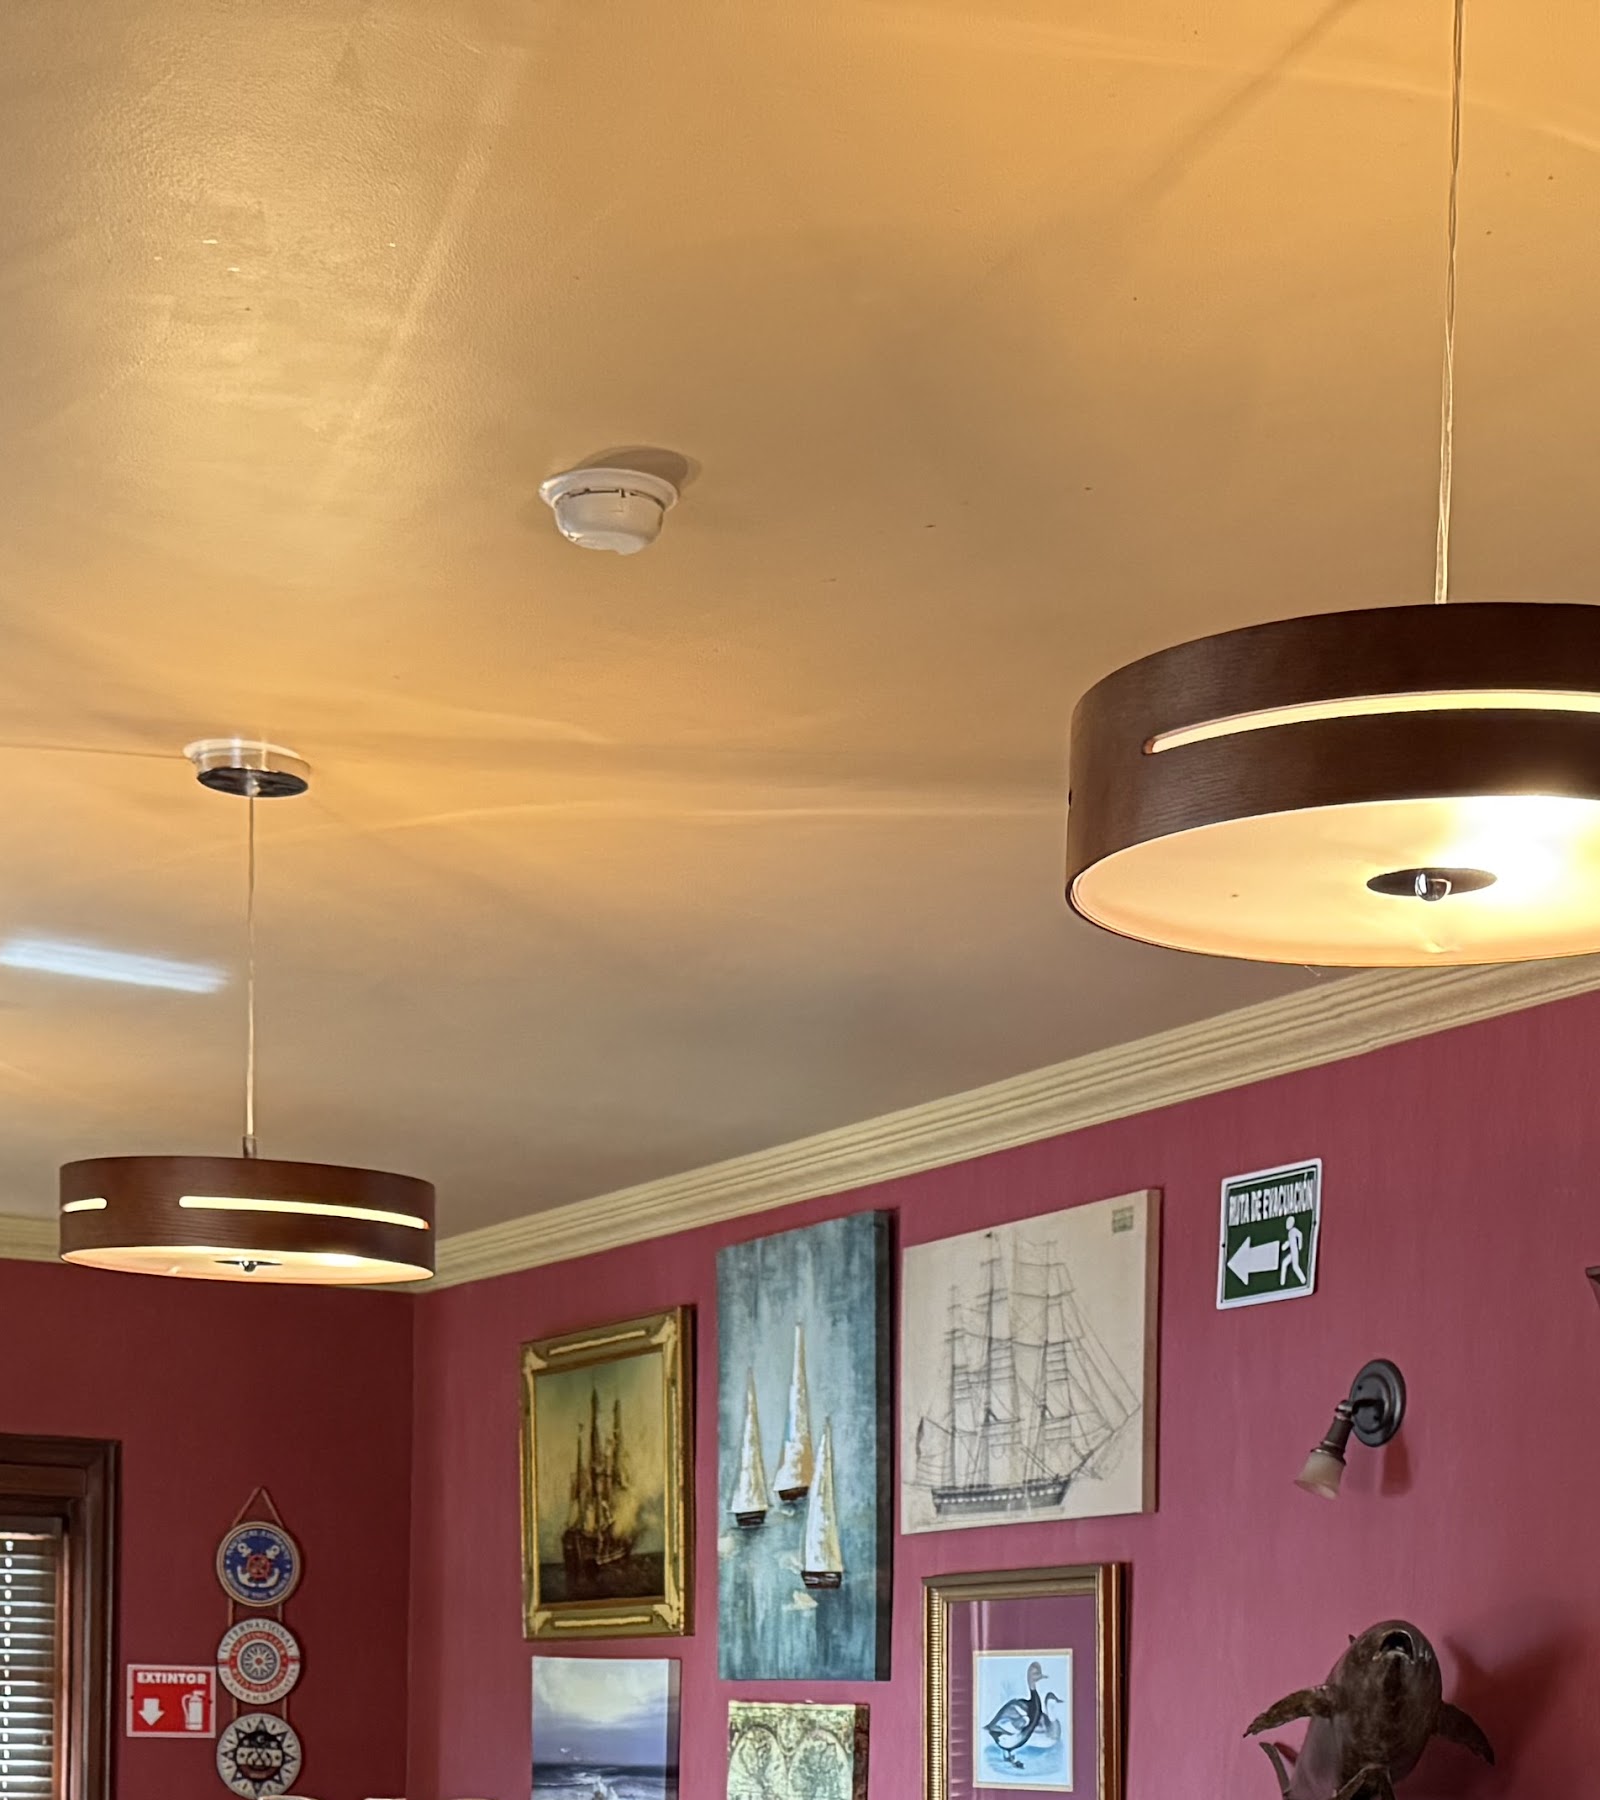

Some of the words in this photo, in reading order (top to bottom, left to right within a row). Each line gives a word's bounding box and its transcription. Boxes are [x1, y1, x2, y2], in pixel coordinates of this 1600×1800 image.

[1228, 1193, 1249, 1226] RUTA
[1250, 1190, 1263, 1222] DE
[136, 1672, 207, 1685] EXTINTOR
